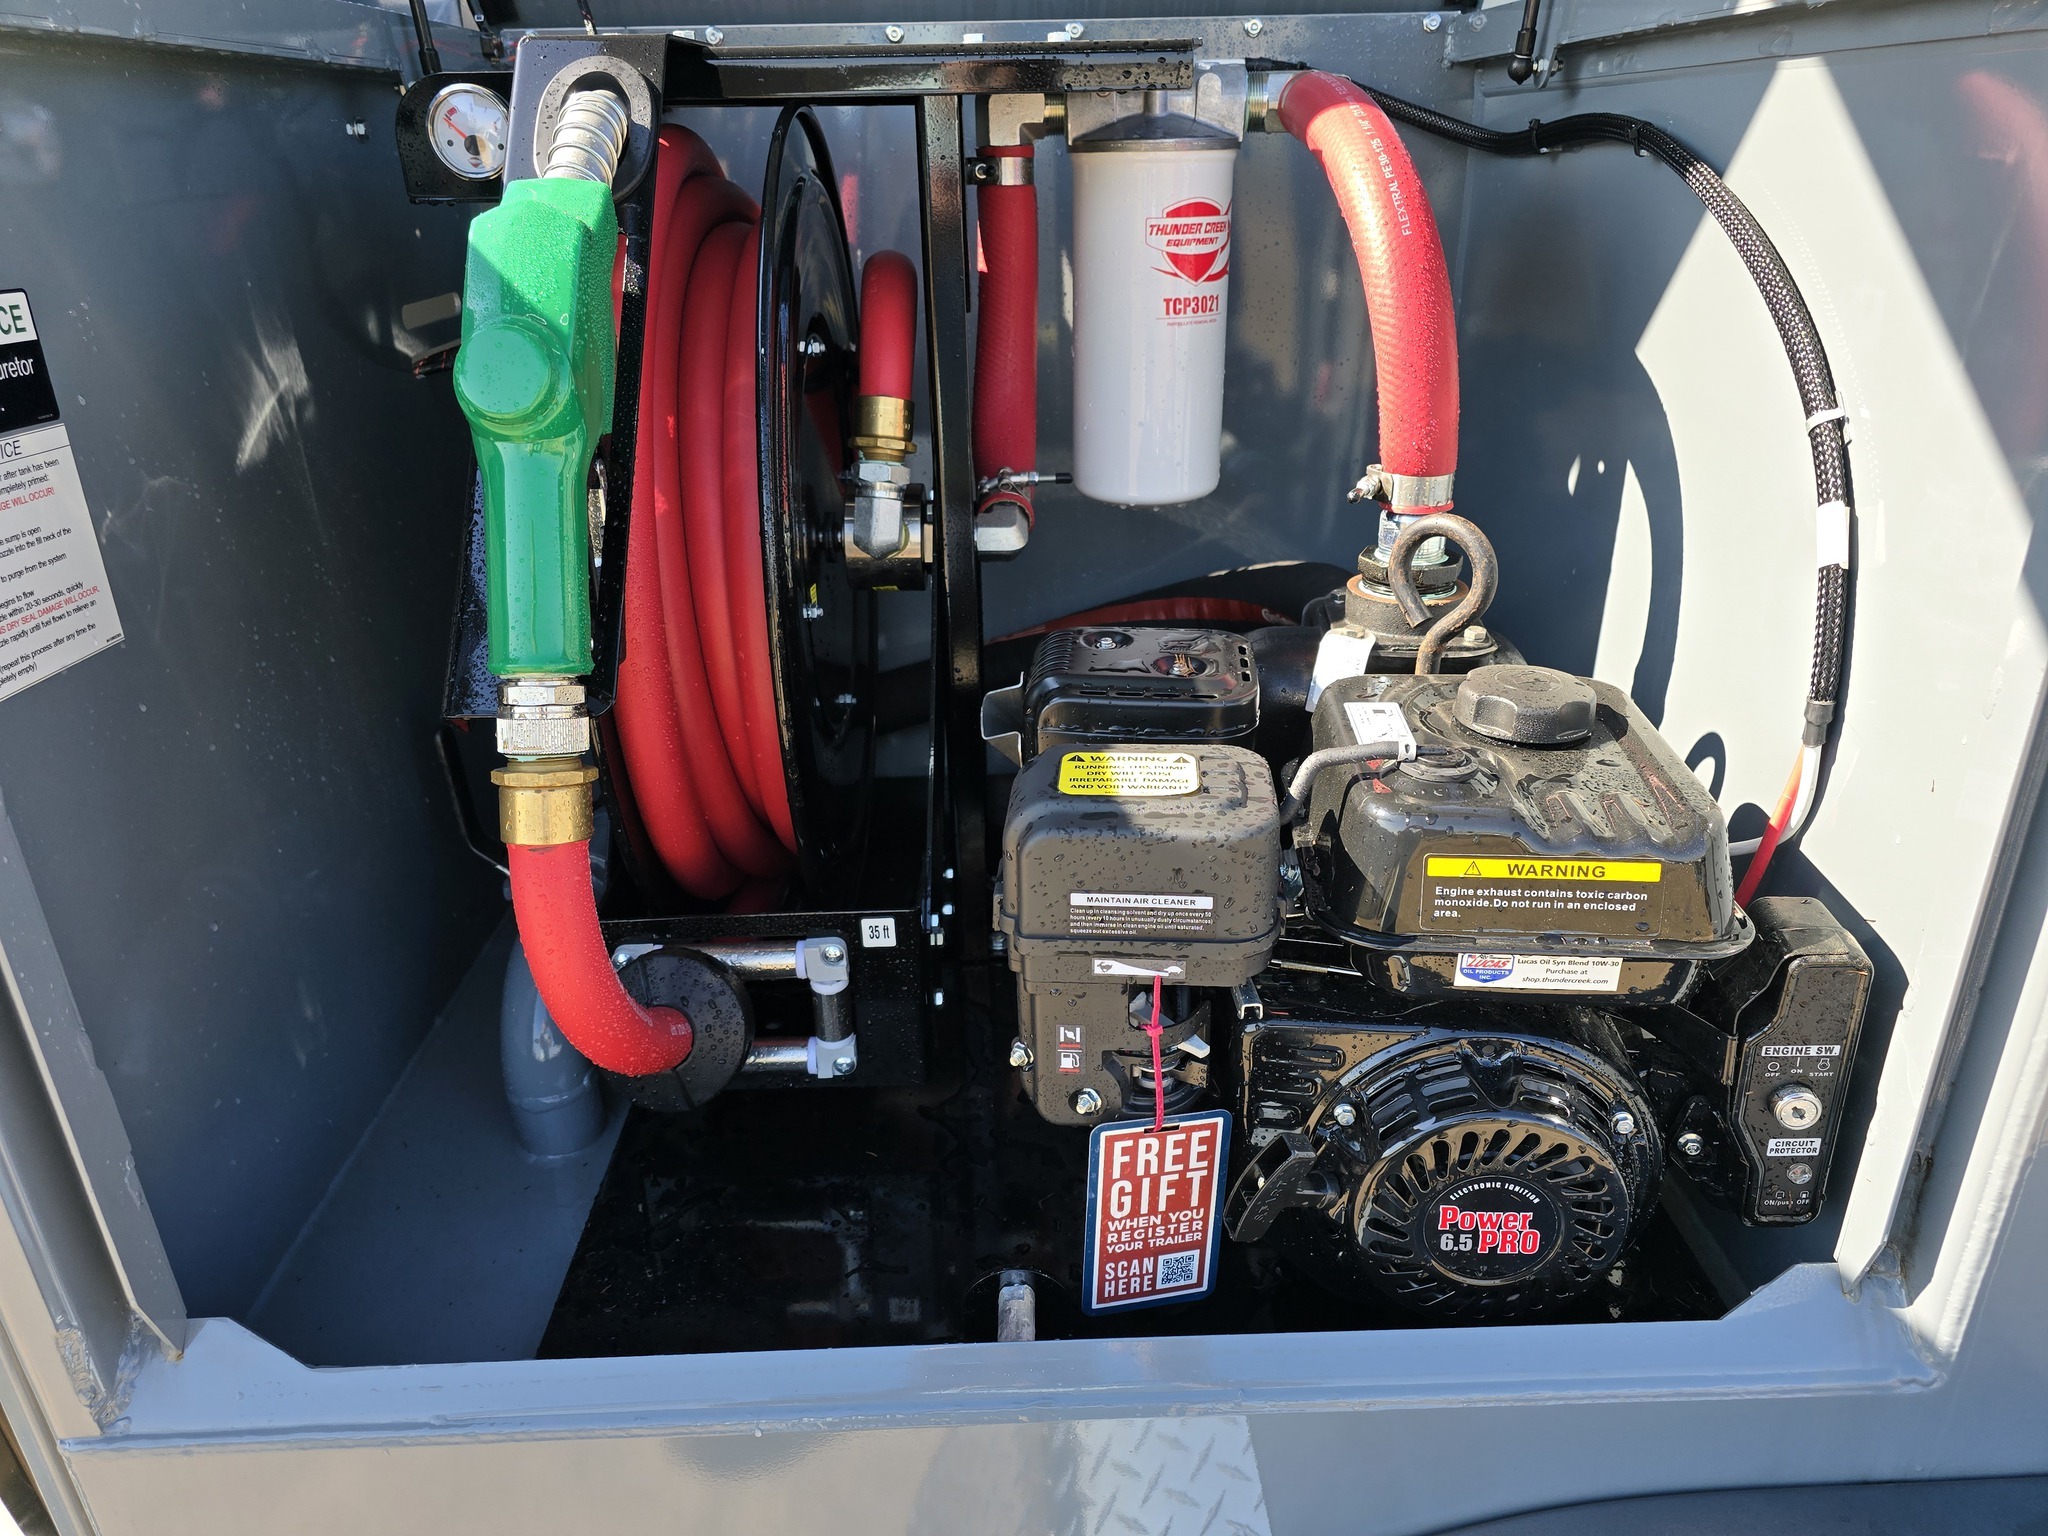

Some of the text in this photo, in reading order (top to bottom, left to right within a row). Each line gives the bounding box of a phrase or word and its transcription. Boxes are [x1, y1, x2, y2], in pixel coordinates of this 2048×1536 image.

[1388, 180, 1412, 236] FLEXTRAL
[1149, 221, 1227, 236] THUNDER CREEK
[1166, 237, 1219, 247] EQUIPMENT
[1163, 294, 1219, 316] TCP3021
[3, 470, 18, 480] after
[18, 465, 32, 475] tank
[32, 463, 44, 472] has
[44, 458, 60, 468] been
[27, 473, 50, 488] primed:
[11, 495, 29, 507] WILL
[28, 487, 55, 501] OCCUR!
[4, 533, 21, 544] sump
[21, 530, 27, 538] is
[27, 526, 41, 537] open
[15, 543, 26, 552] into
[26, 540, 36, 548] the
[43, 532, 56, 542] neck
[56, 529, 62, 537] of
[62, 527, 72, 535] the
[0, 553, 67, 583] to purge from the system
[8, 606, 25, 618] within
[25, 597, 41, 611] 20-30
[66, 581, 84, 595] quickly
[22, 590, 34, 600] flow
[6, 619, 20, 631] DRY
[20, 612, 38, 625] SEAL
[37, 601, 64, 618] DAMAGE
[63, 595, 78, 606] WILL
[10, 629, 29, 642] rapidly
[29, 622, 41, 634] until
[41, 618, 52, 628] fuel
[52, 612, 66, 623] flows
[66, 610, 73, 618] to
[72, 602, 90, 614] relieve
[89, 599, 97, 607] an
[20, 653, 31, 663] this
[31, 642, 53, 659] process
[52, 637, 65, 647] after
[65, 632, 76, 642] any
[75, 626, 87, 637] time
[87, 622, 96, 631] the
[17, 661, 37, 677] empty)
[1507, 863, 1605, 878] WARNING
[1087, 896, 1131, 904] MAINTAIN
[1151, 898, 1196, 906] CLEANER
[1435, 886, 1648, 901] Engine exhaust contains toxic carbon
[1433, 910, 1461, 918] area.
[1511, 900, 1530, 908] not
[1532, 901, 1551, 909] run
[1553, 900, 1564, 909] in
[1583, 901, 1636, 911] enclosed
[868, 924, 890, 939] 35 ft
[1467, 957, 1510, 968] LUCAS
[1522, 976, 1609, 984] shop.thundercreek.com
[1764, 1046, 1837, 1055] ENGINE SW.
[1112, 1130, 1211, 1180] FREE
[1110, 1170, 1208, 1219] GIFT
[1449, 1181, 1541, 1204] ELECTRONIC IGNITION
[1107, 1208, 1205, 1232] WHEN YOU
[1438, 1205, 1533, 1231] Power
[1106, 1232, 1202, 1254] YOUR TRAILER
[1107, 1220, 1203, 1244] REGISTER
[1440, 1230, 1540, 1254] 6.5 PRO
[1105, 1256, 1154, 1280] SCAN
[1104, 1274, 1153, 1298] HERE
